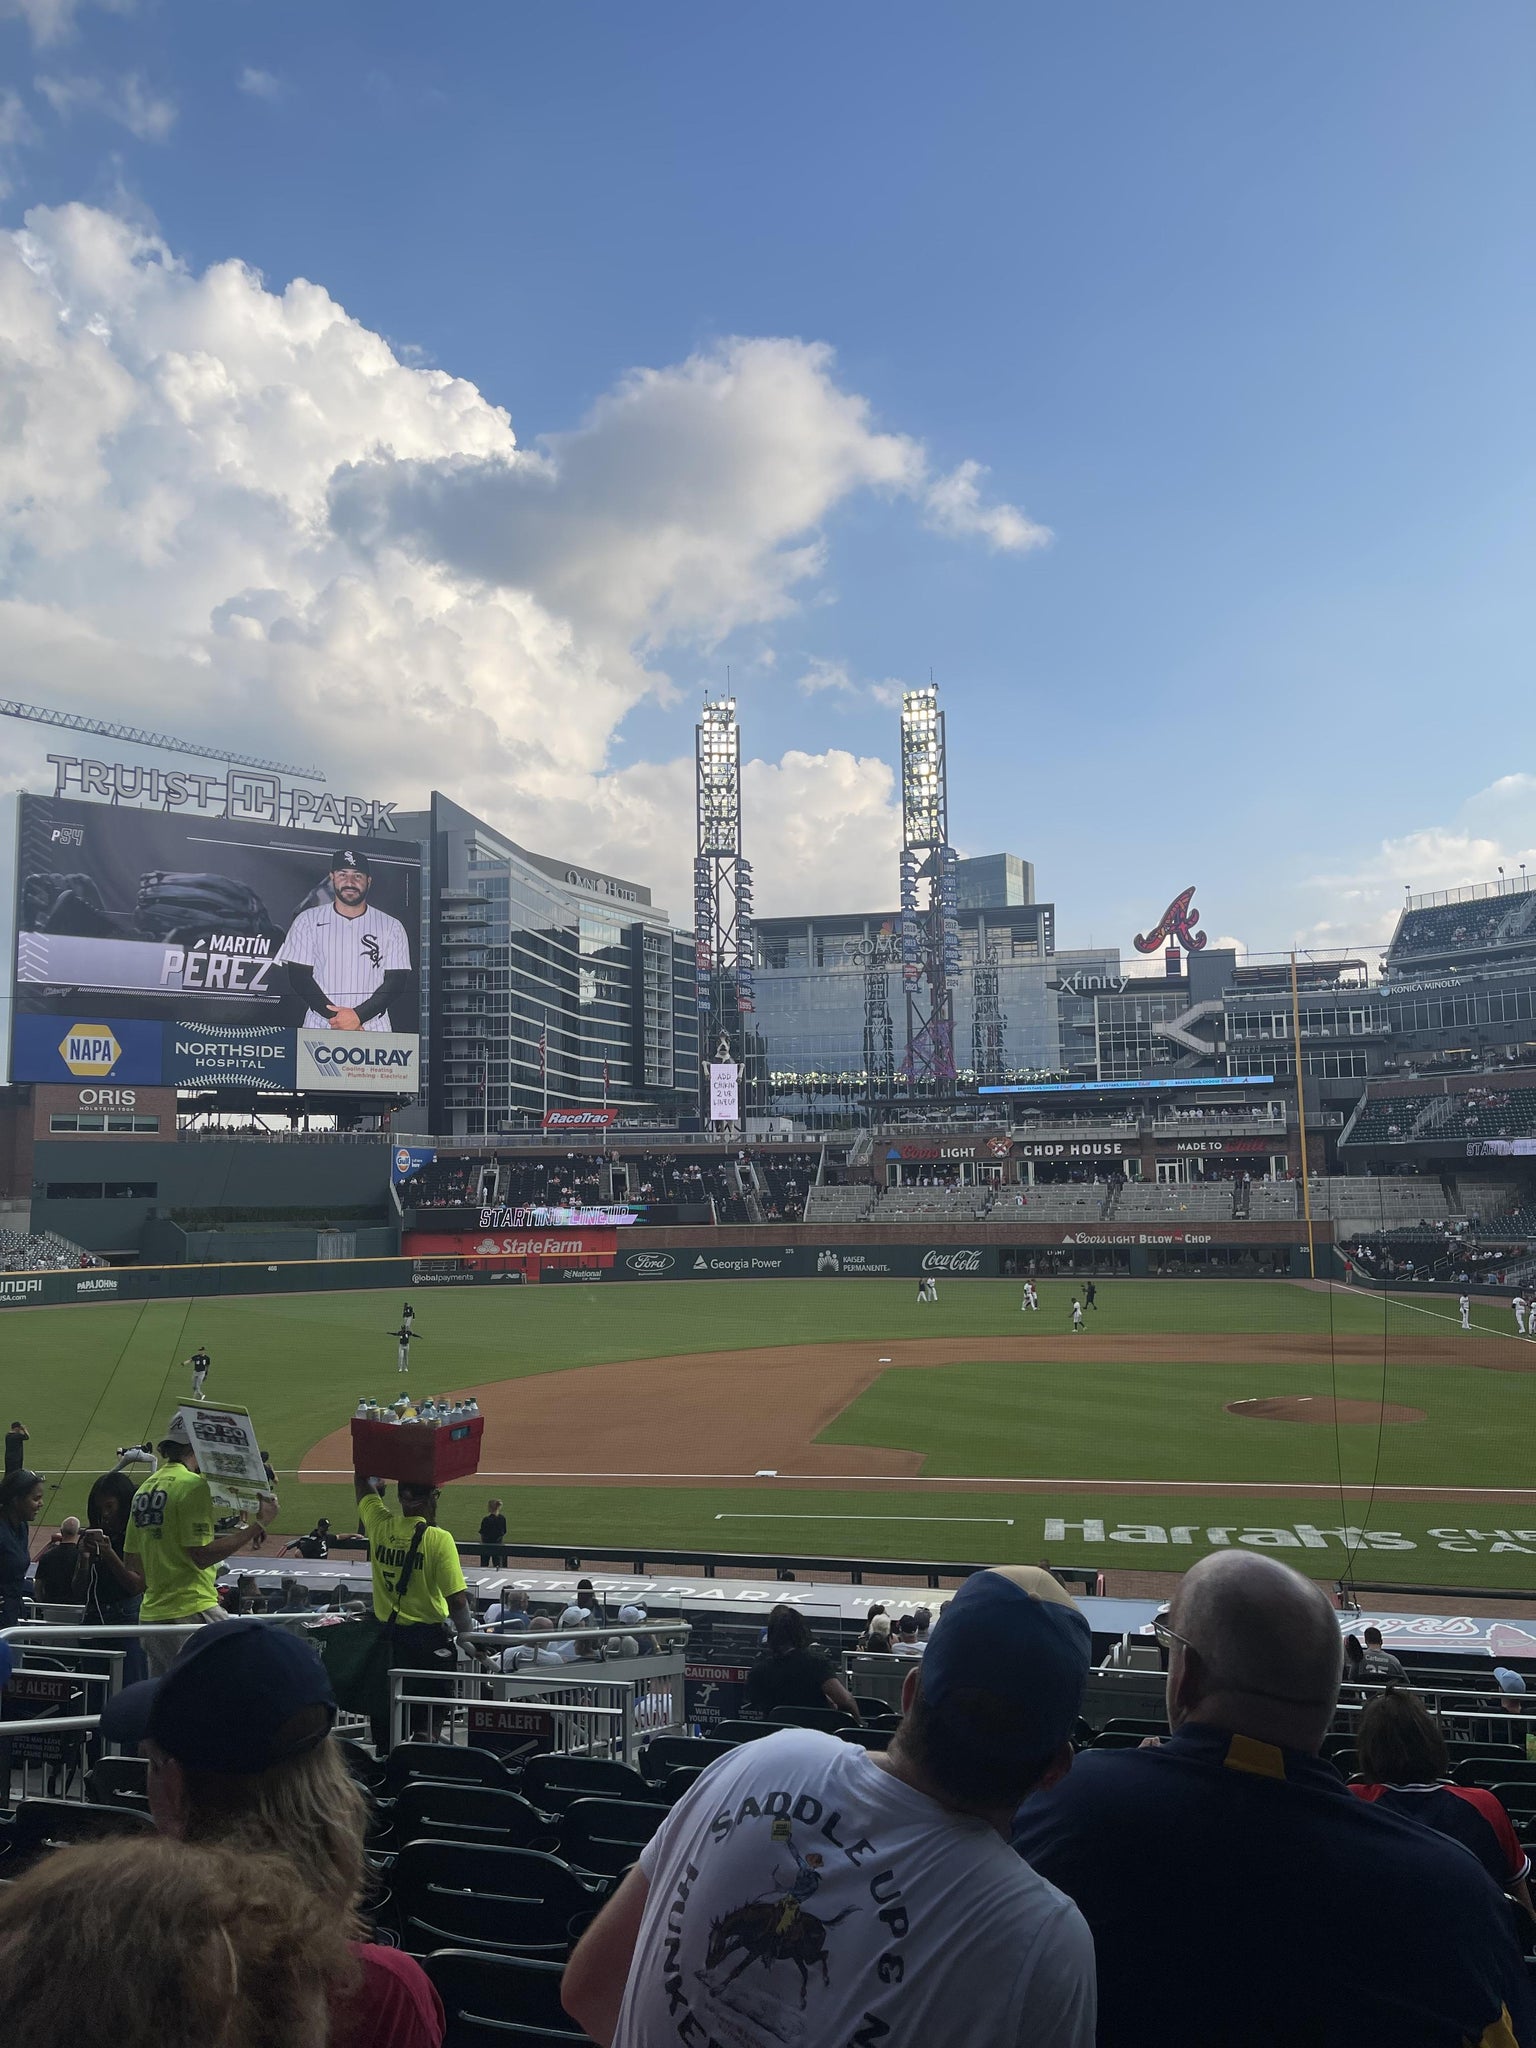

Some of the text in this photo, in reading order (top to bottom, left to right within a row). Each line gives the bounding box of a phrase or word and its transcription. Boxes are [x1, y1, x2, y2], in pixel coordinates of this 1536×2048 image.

[47, 754, 398, 833] TRUIST PARK
[209, 934, 271, 955] MARTÍN
[160, 938, 274, 992] PÉREZ
[1060, 971, 1131, 995] xfinity
[1391, 980, 1460, 994] KONICA MINOLTA
[70, 1039, 111, 1061] NAPA
[175, 1042, 285, 1058] NORTHSIDE
[314, 1046, 413, 1066] COOLRAY
[195, 1058, 265, 1069] HOSPITAL
[79, 1089, 136, 1105] ORIS
[548, 1112, 609, 1125] RaceTrac
[901, 1146, 976, 1159] Coors LIGHT
[1023, 1143, 1123, 1156] CHOP HOUSE
[1177, 1142, 1207, 1151] MADE
[1208, 1142, 1222, 1150] TO
[479, 1206, 630, 1227] STARTING LINEUP
[1075, 1232, 1107, 1244] Coors
[1107, 1235, 1136, 1244] LIGHT
[1139, 1234, 1173, 1244] BELOW
[1185, 1233, 1212, 1243] CHOP
[634, 1254, 667, 1269] Ford
[710, 1258, 782, 1272] Georgia Power
[843, 1264, 888, 1272] PERMANENTE
[921, 1250, 983, 1271] Coca-Cola
[572, 1270, 602, 1278] National
[1044, 1518, 1417, 1552] Harrah's
[659, 1586, 815, 1604] PARK
[684, 1667, 730, 1680] CAUTION
[26, 1679, 64, 1697] ALERT
[695, 1707, 721, 1716] WATCH
[474, 1711, 542, 1731] BE ALERT
[711, 1791, 877, 1868] SADDLE
[870, 1869, 910, 1939] UP
[663, 1862, 722, 2048] HUNKE
